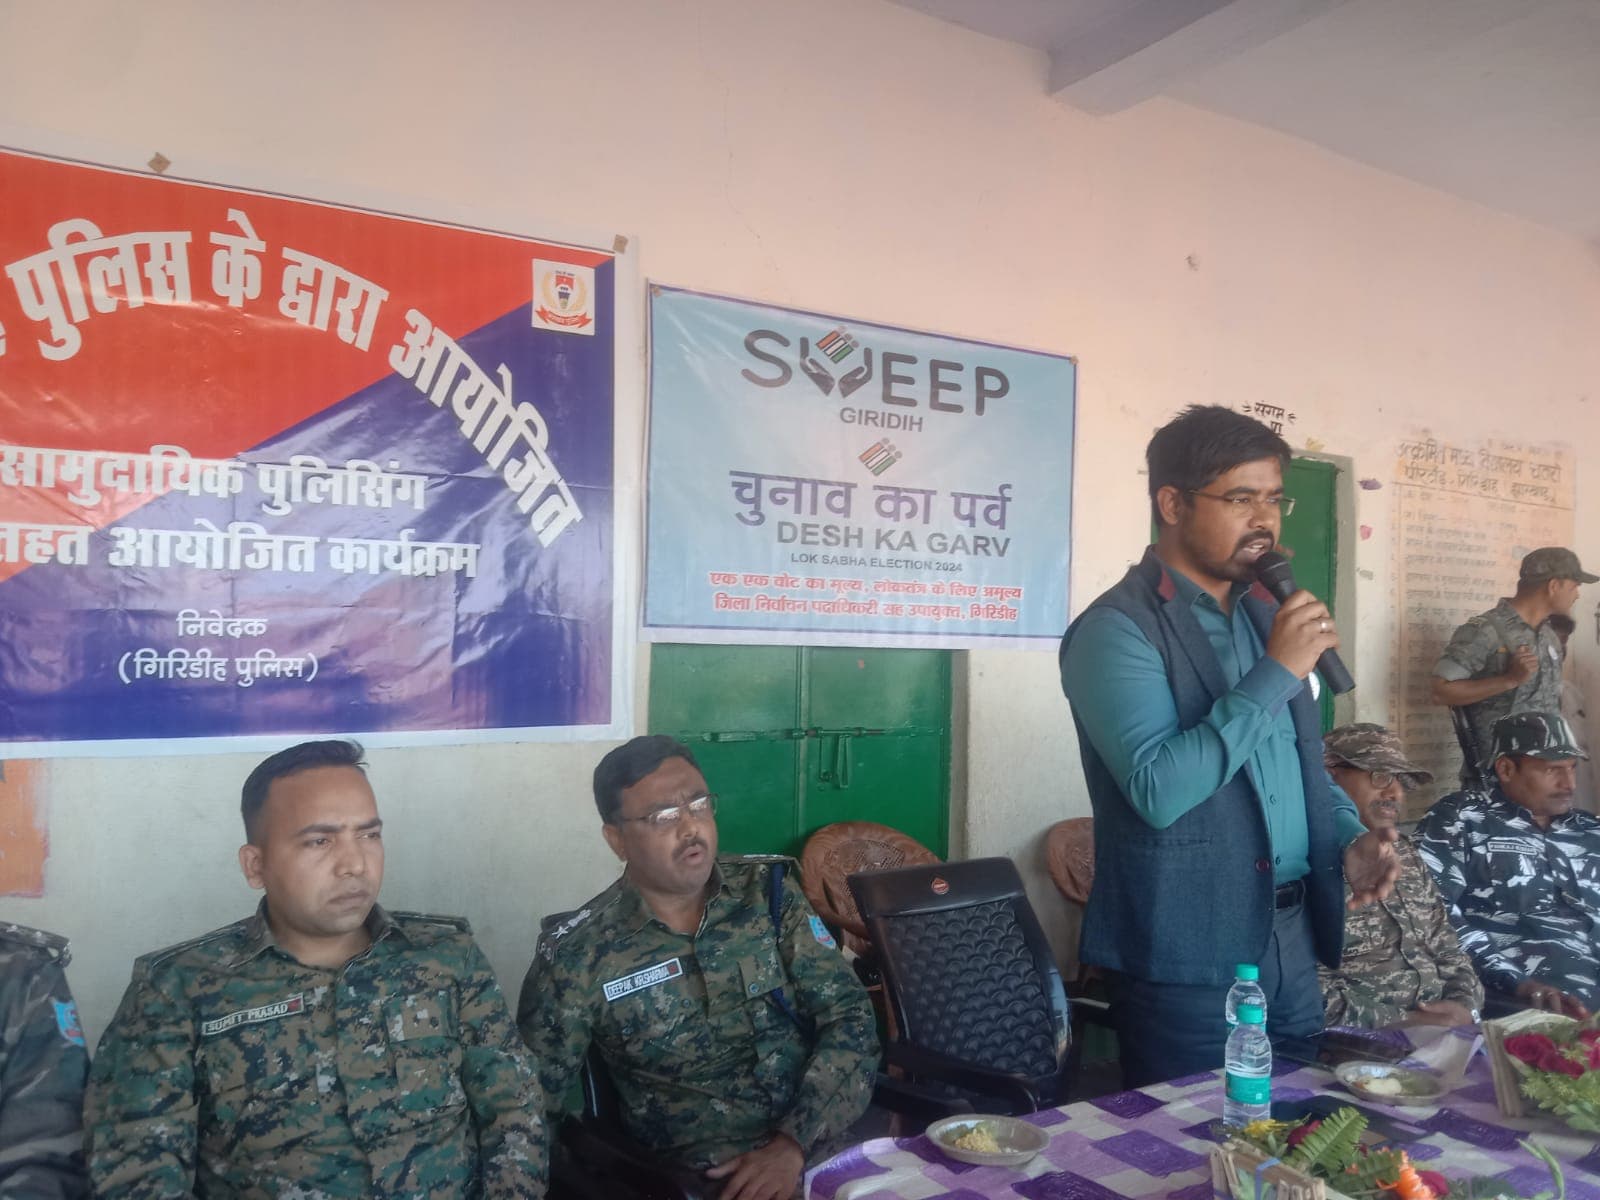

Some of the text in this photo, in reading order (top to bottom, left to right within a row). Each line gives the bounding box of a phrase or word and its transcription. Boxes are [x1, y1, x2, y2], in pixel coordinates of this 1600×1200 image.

[5, 208, 584, 548] पुलिस के द्वारा आयोजित
[741, 329, 1010, 416] SWEEP
[840, 407, 923, 432] GIRIDIH
[0, 444, 428, 517] सामुदायिक पुलिसिंग
[729, 470, 1013, 530] चुनाव का पर्व
[108, 518, 319, 573] आयोजित
[328, 527, 480, 578] कार्यक्रम
[776, 521, 1011, 557] DESH KA GARV
[791, 553, 963, 572] LOK SABHA ELECTION 2024
[709, 572, 737, 585] एक
[743, 574, 769, 587] एक
[774, 572, 800, 588] वोट
[806, 577, 825, 590] का
[873, 579, 927, 594] लोकतंत्र
[932, 581, 945, 595] के
[950, 582, 977, 596] लिए
[982, 586, 1022, 601] अमूल्य
[177, 609, 268, 638] निवेदक
[715, 592, 749, 610] जिला
[755, 594, 808, 612] निर्वाचन
[883, 603, 903, 616] सह
[970, 603, 1017, 620] गिरिडीह
[118, 650, 318, 687] (गिरिडीह पुलिस)
[247, 1003, 288, 1020] PRASAD
